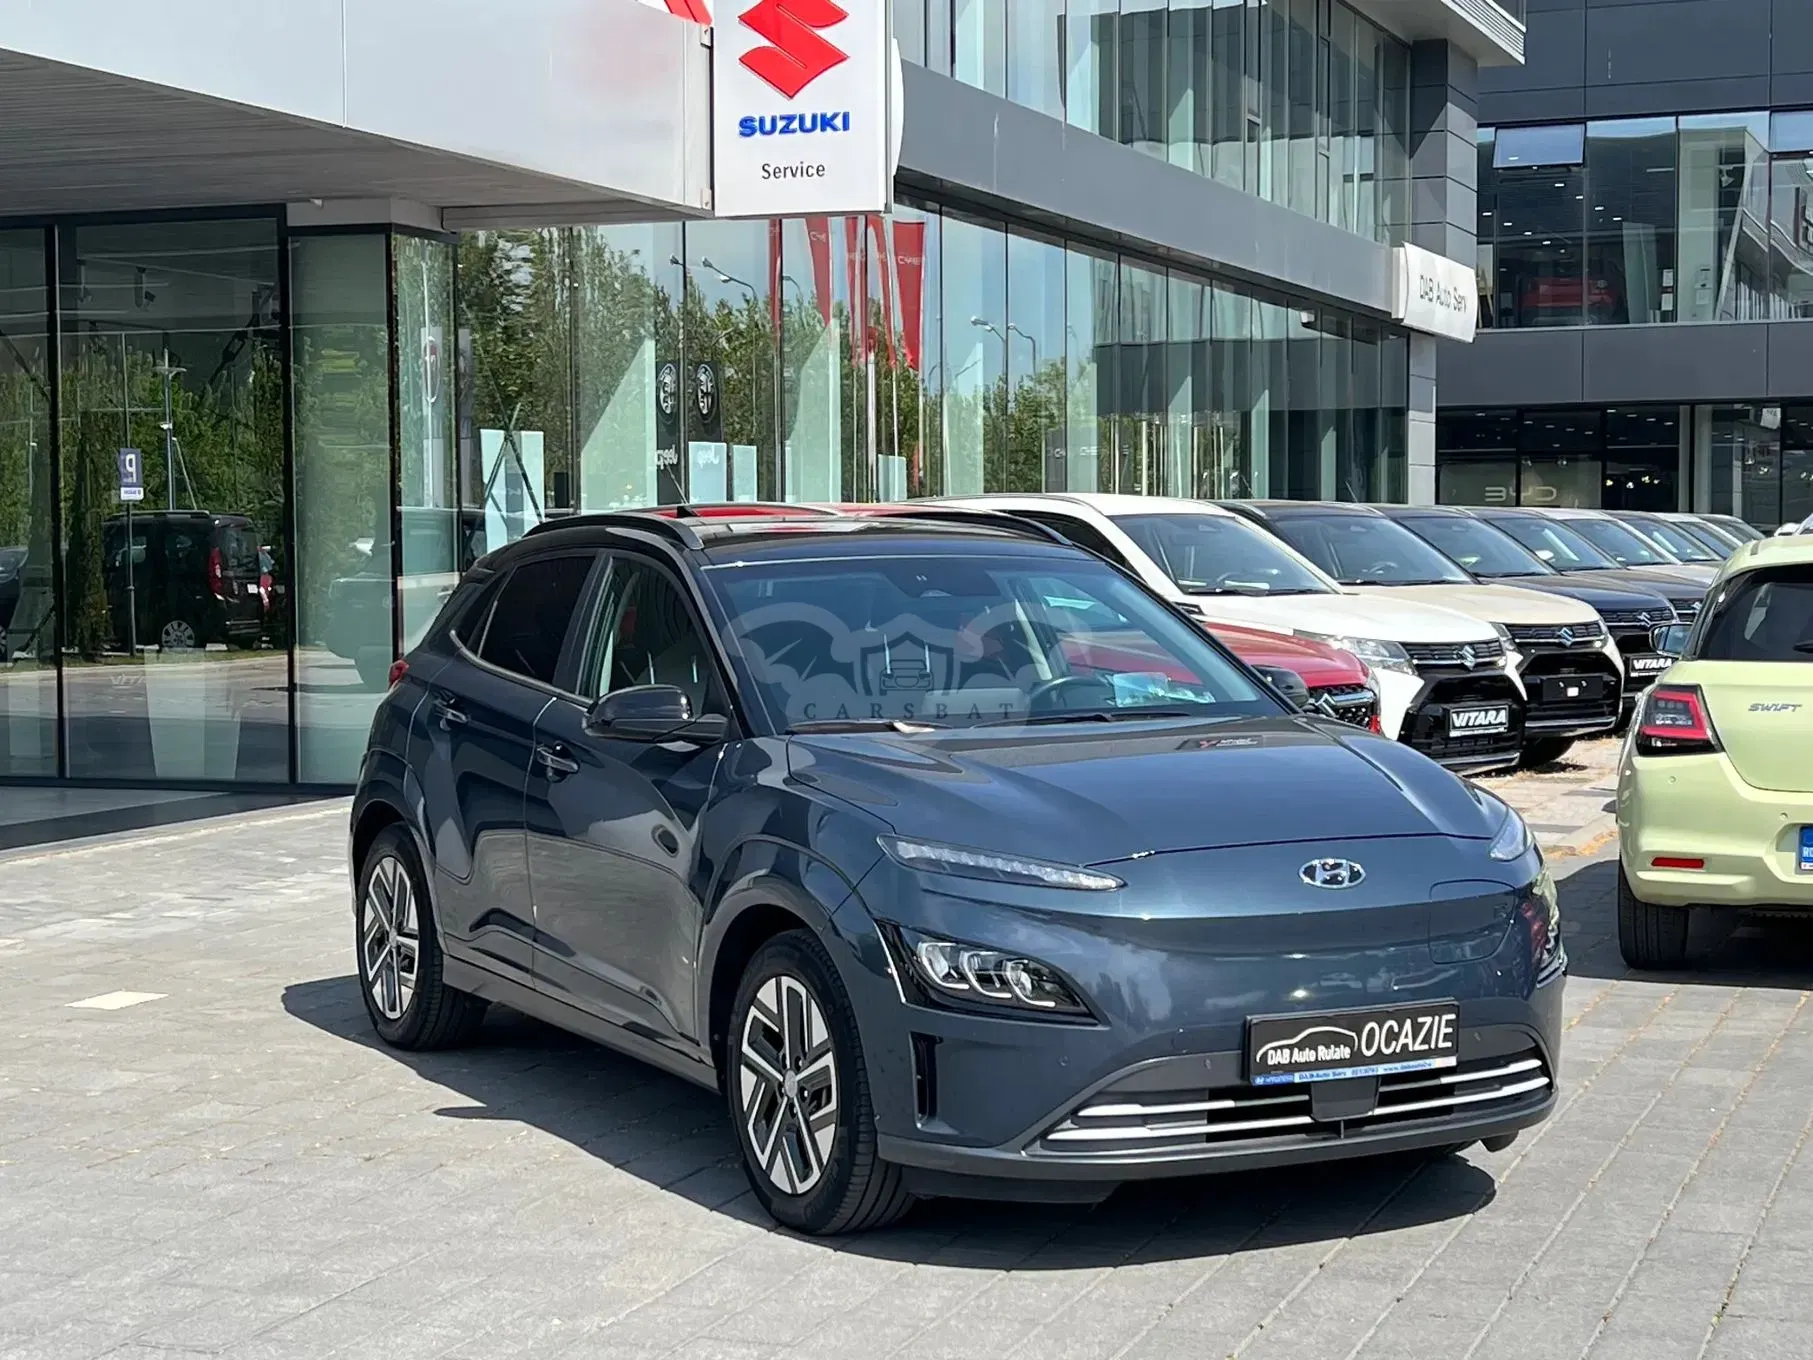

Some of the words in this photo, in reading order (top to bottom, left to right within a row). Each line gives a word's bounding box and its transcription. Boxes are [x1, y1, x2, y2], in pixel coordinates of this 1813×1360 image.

[738, 111, 850, 138] SUZUKI
[761, 161, 826, 180] Service
[1419, 274, 1434, 303] DAB
[1435, 281, 1451, 309] Auto
[1453, 286, 1467, 313] Serv
[1484, 486, 1558, 502] BYD
[1633, 658, 1672, 670] VITARA
[1748, 703, 1803, 713] SWIFT
[1452, 709, 1506, 727] VITARA
[1360, 1013, 1457, 1057] OCAZIE
[1267, 1048, 1290, 1066] DAB
[1291, 1046, 1316, 1064] Auto
[1317, 1044, 1351, 1061] Rulate
